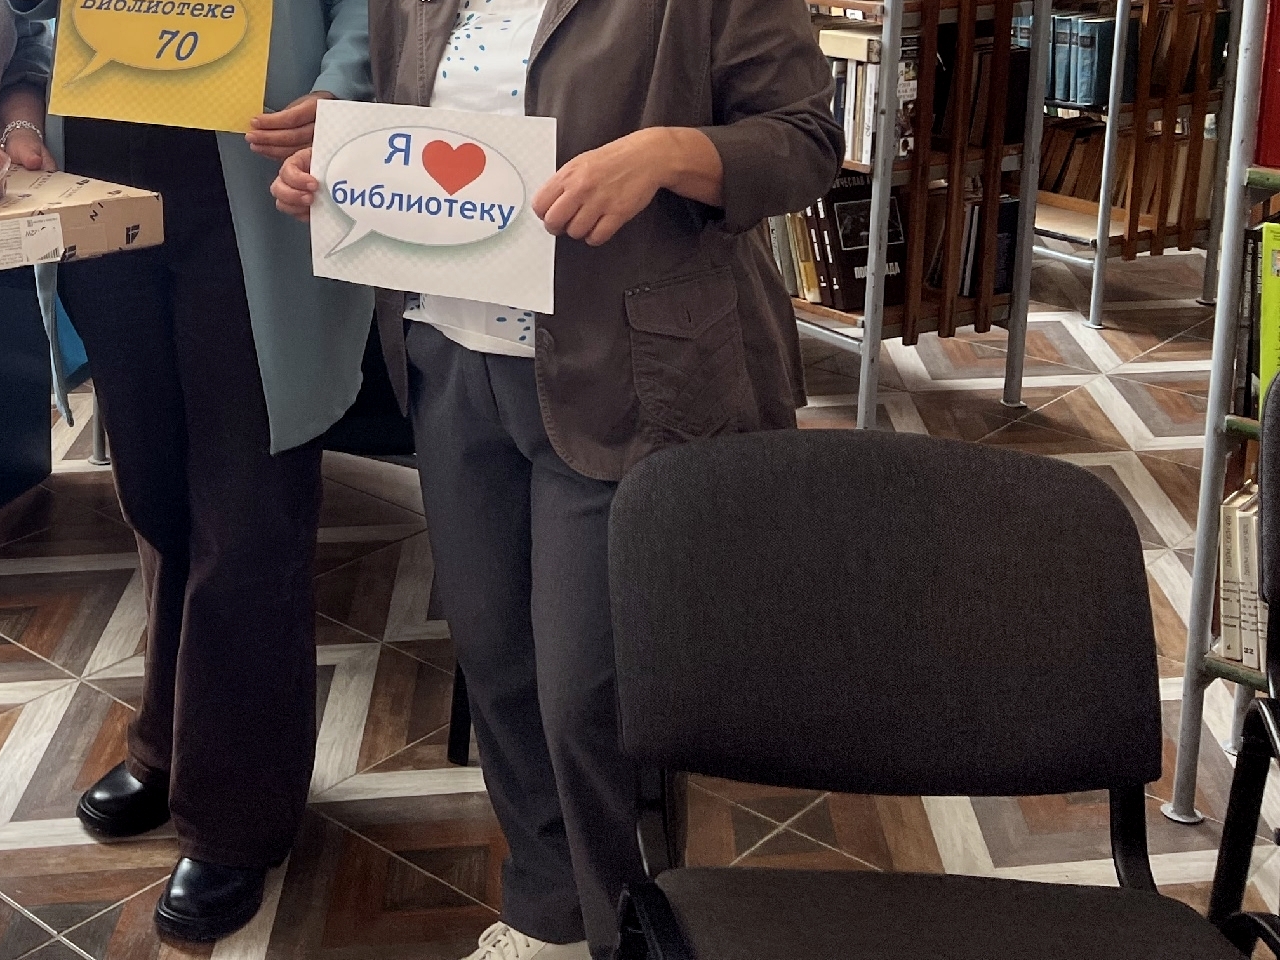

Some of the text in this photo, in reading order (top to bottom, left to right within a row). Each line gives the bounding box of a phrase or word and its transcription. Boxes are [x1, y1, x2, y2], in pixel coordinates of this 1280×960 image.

[155, 29, 199, 61] 70
[384, 133, 412, 166] Я
[332, 180, 515, 230] библиотеку
